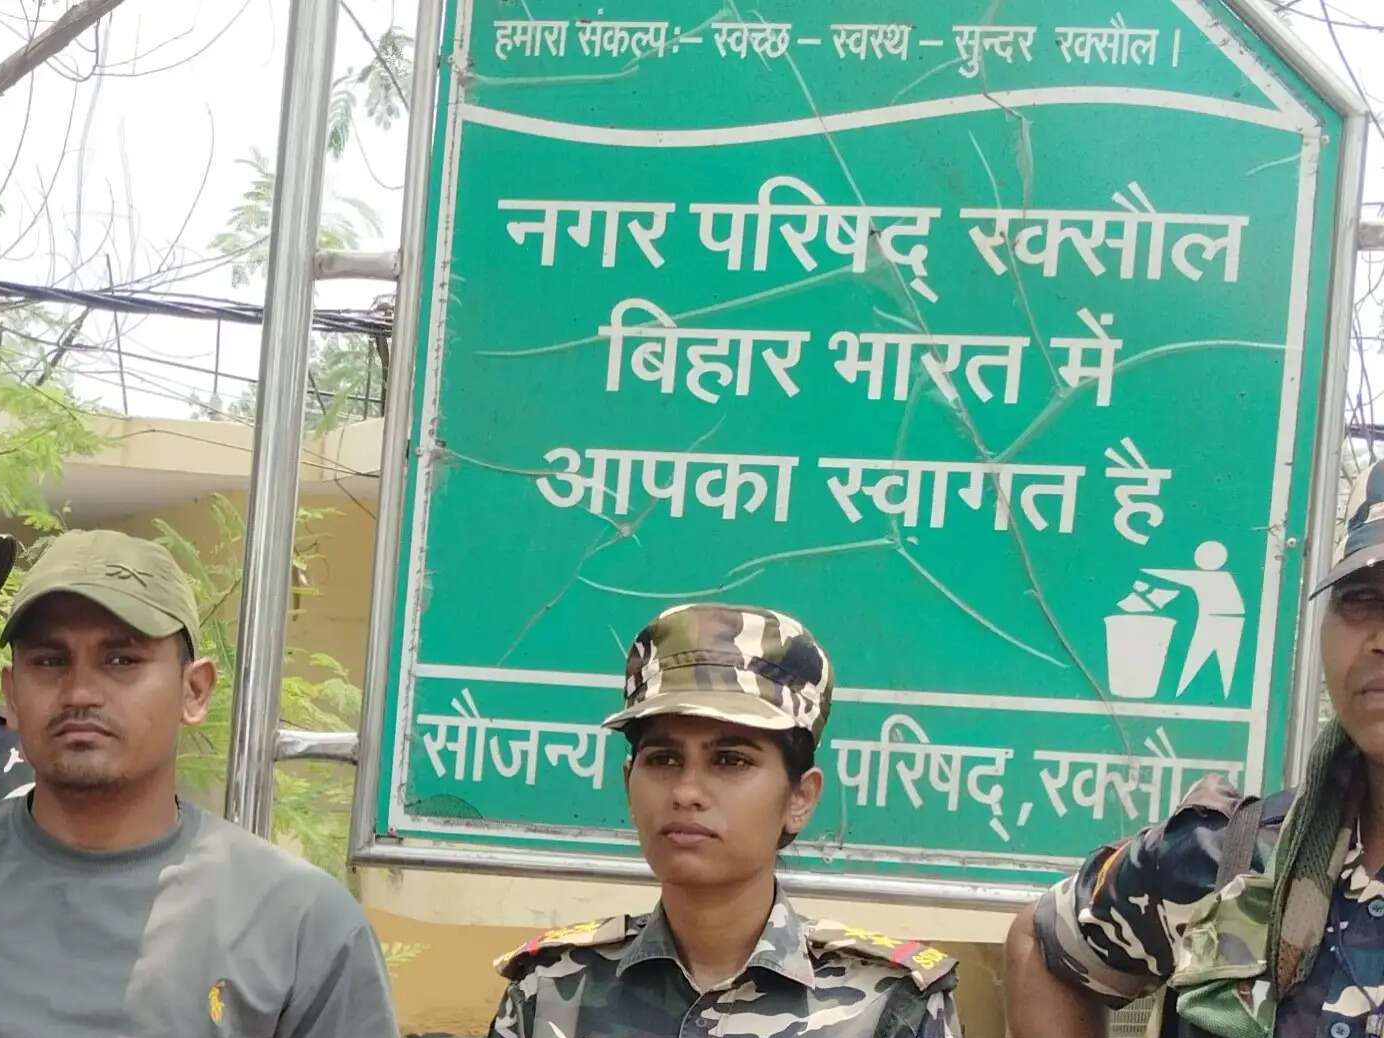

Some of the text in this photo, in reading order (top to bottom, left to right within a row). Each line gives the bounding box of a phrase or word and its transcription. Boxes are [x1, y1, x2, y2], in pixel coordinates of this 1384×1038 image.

[493, 19, 570, 60] हमारा
[711, 22, 793, 60] स्वच्छ
[952, 26, 1038, 79] सुन्दर
[1055, 11, 1160, 66] रक्सौल
[497, 175, 1250, 303] नगर परिषद् रक्सौल
[598, 298, 1124, 408] बिहार भारत में
[536, 436, 1173, 546] आपका स्वागत है
[417, 687, 613, 790] सौजन्य
